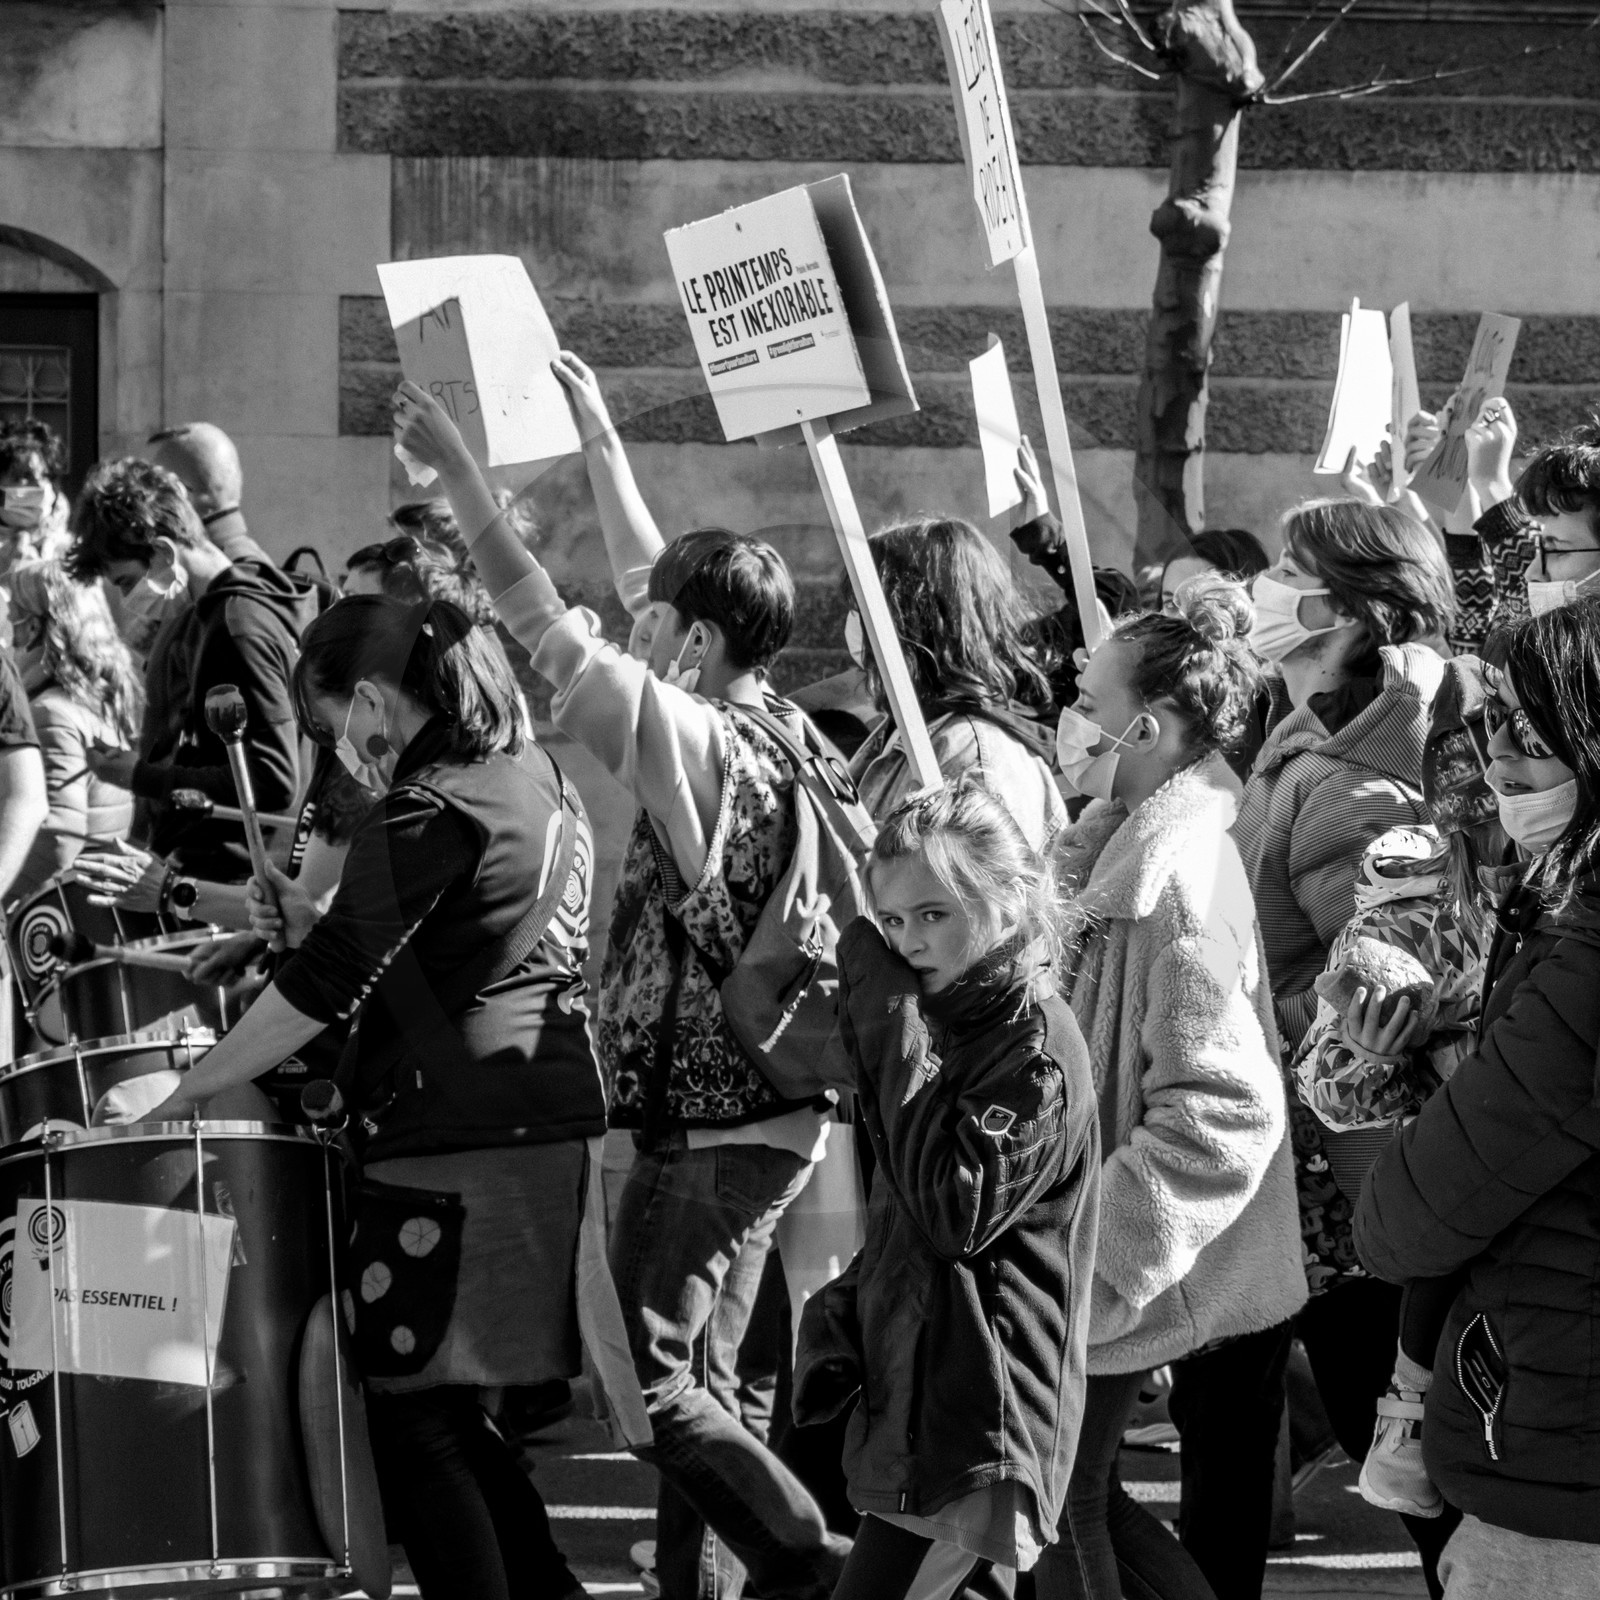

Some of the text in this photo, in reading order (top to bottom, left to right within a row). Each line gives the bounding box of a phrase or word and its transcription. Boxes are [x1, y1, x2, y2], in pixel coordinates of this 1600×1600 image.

[978, 94, 995, 147] DE
[682, 247, 793, 314] LE PRINTEMPS
[708, 278, 834, 348] EST INEXORABLE
[82, 1290, 166, 1311] ESSENTIEL
[172, 1297, 177, 1312] !
